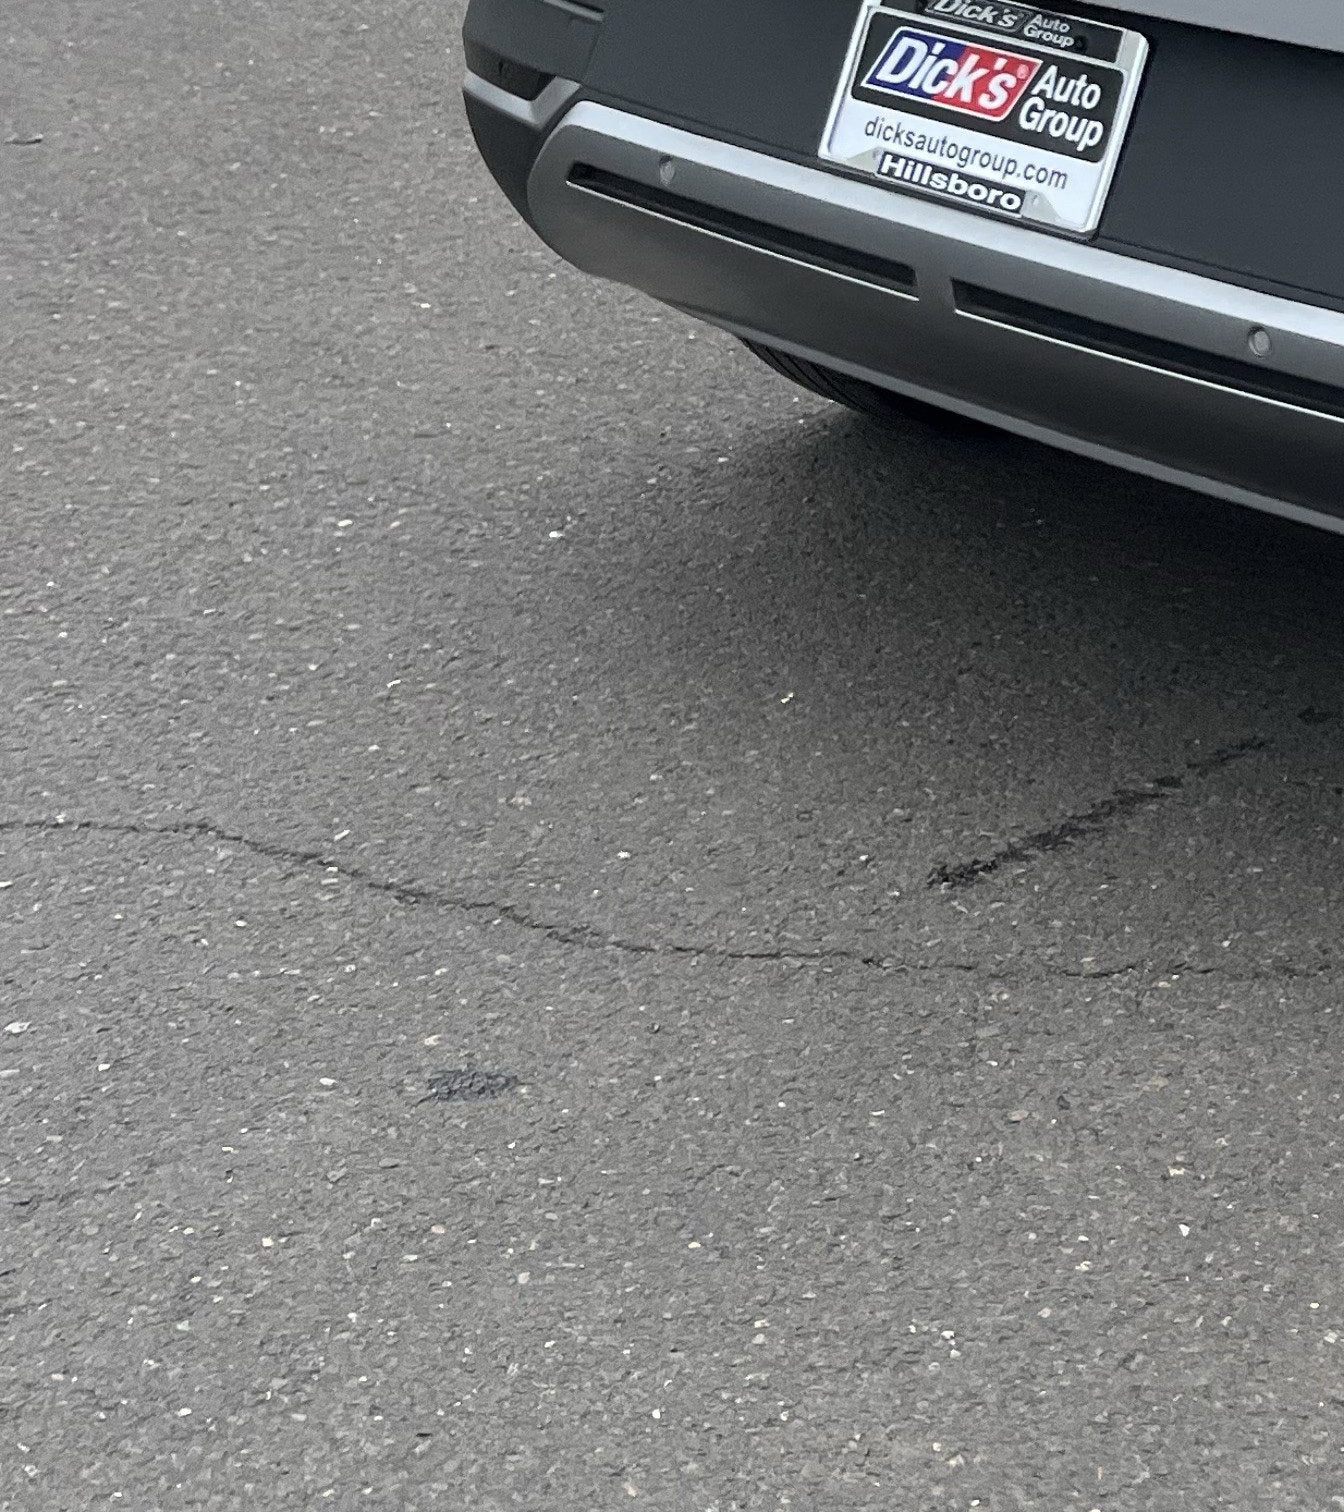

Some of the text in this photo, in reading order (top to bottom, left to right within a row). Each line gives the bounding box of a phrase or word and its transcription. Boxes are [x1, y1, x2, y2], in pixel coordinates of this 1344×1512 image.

[1023, 23, 1075, 49] Group
[1030, 13, 1071, 33] Auto
[875, 35, 1017, 111] Dick's
[1031, 64, 1101, 110] Auto
[1018, 96, 1104, 152] Group
[864, 116, 1068, 190] dicksautogroup.com
[879, 153, 1023, 212] Hillsboro
